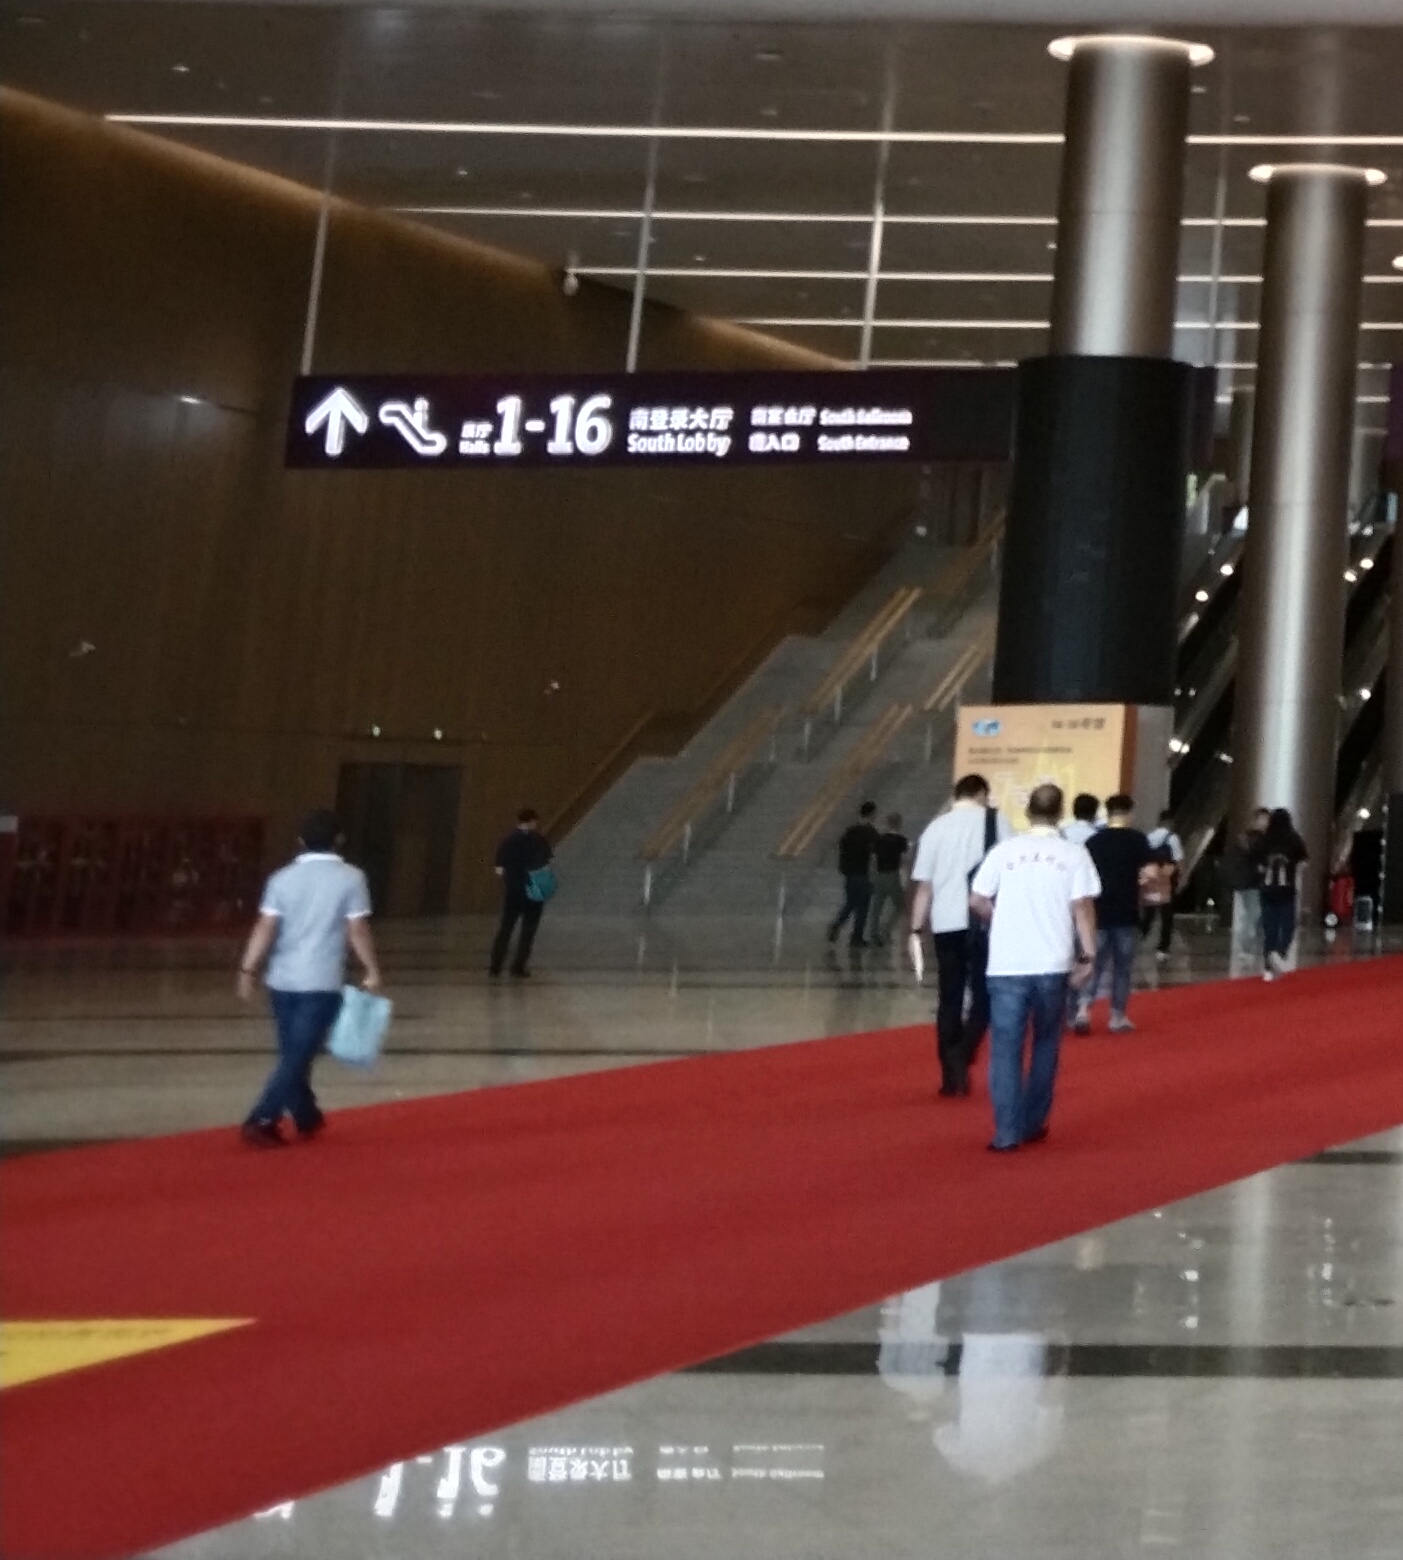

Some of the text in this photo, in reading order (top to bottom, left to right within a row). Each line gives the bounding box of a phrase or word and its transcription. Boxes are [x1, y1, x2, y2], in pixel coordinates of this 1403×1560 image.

[495, 393, 613, 456] 1-16
[628, 406, 735, 431] 南登录大厅
[458, 440, 491, 455] Halls
[627, 432, 732, 458] South Lobby
